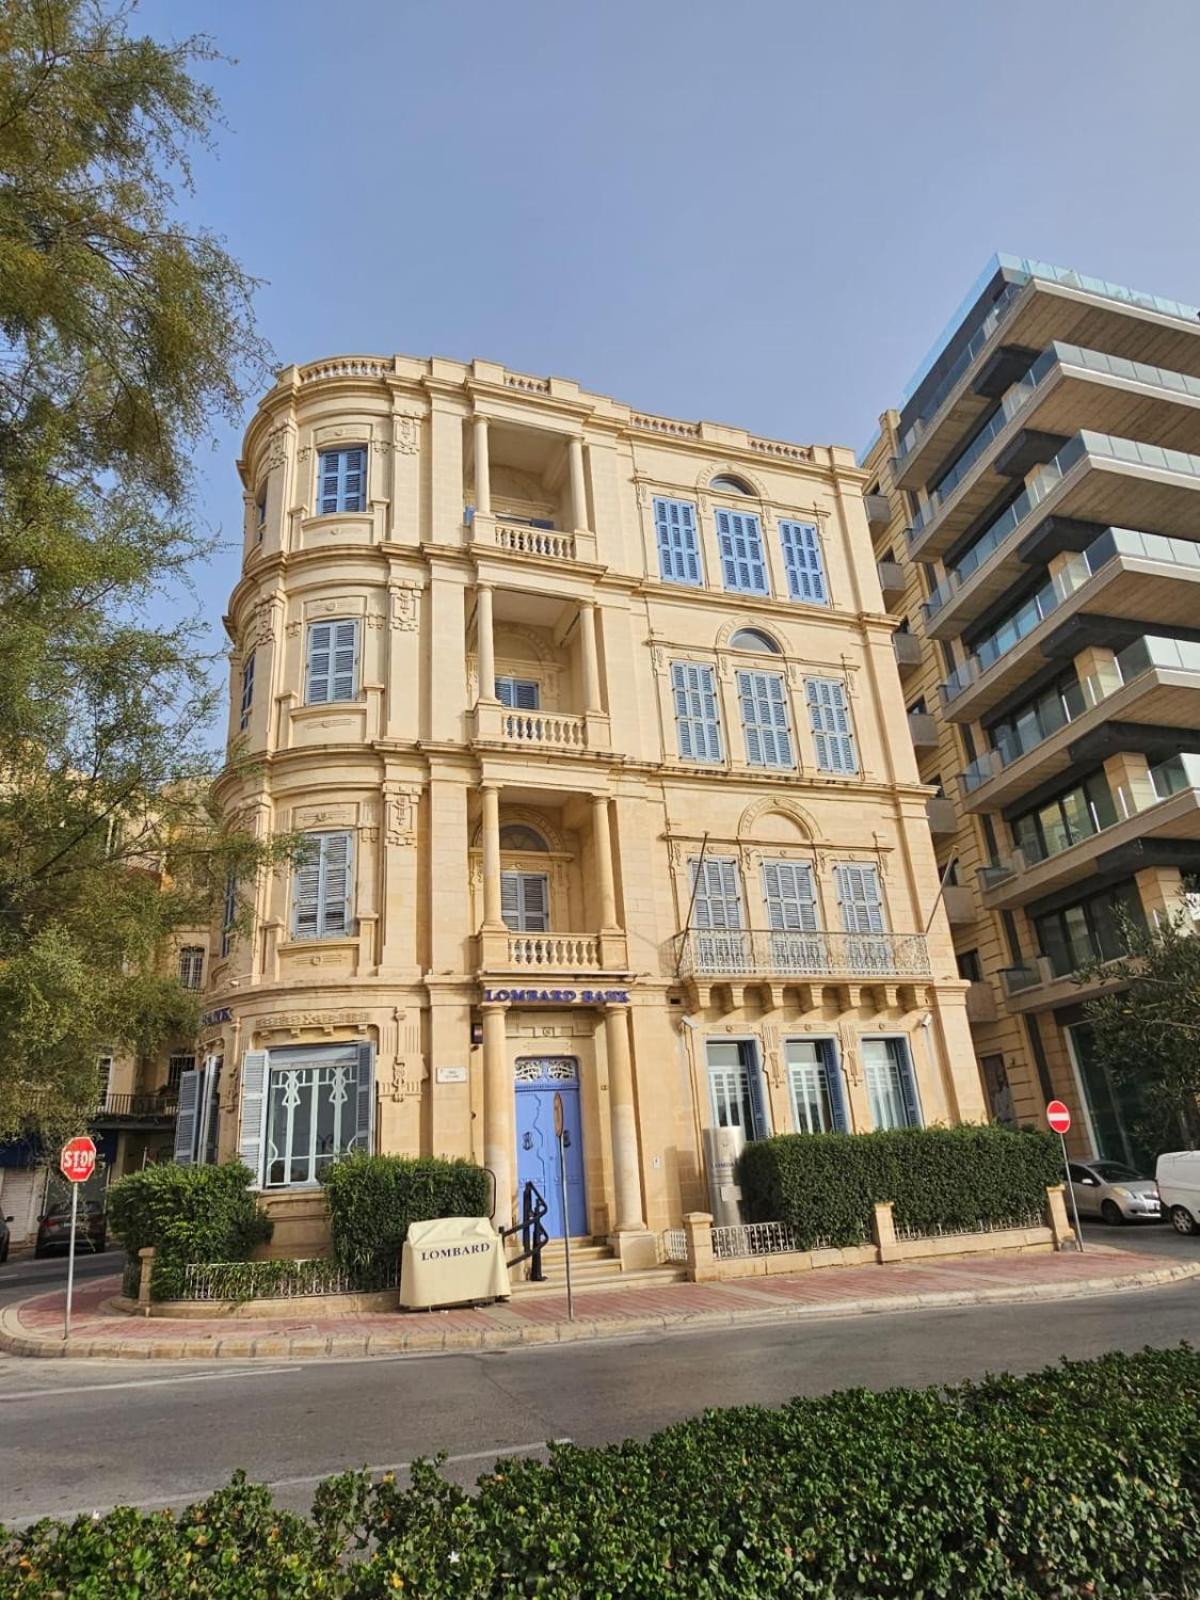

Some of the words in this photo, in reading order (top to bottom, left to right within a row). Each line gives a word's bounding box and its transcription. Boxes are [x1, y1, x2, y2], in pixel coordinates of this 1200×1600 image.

[484, 989, 577, 1003] LOMBARD
[580, 990, 630, 1003] BANK
[63, 1150, 96, 1168] STOP
[421, 1242, 490, 1261] LOMBARD
